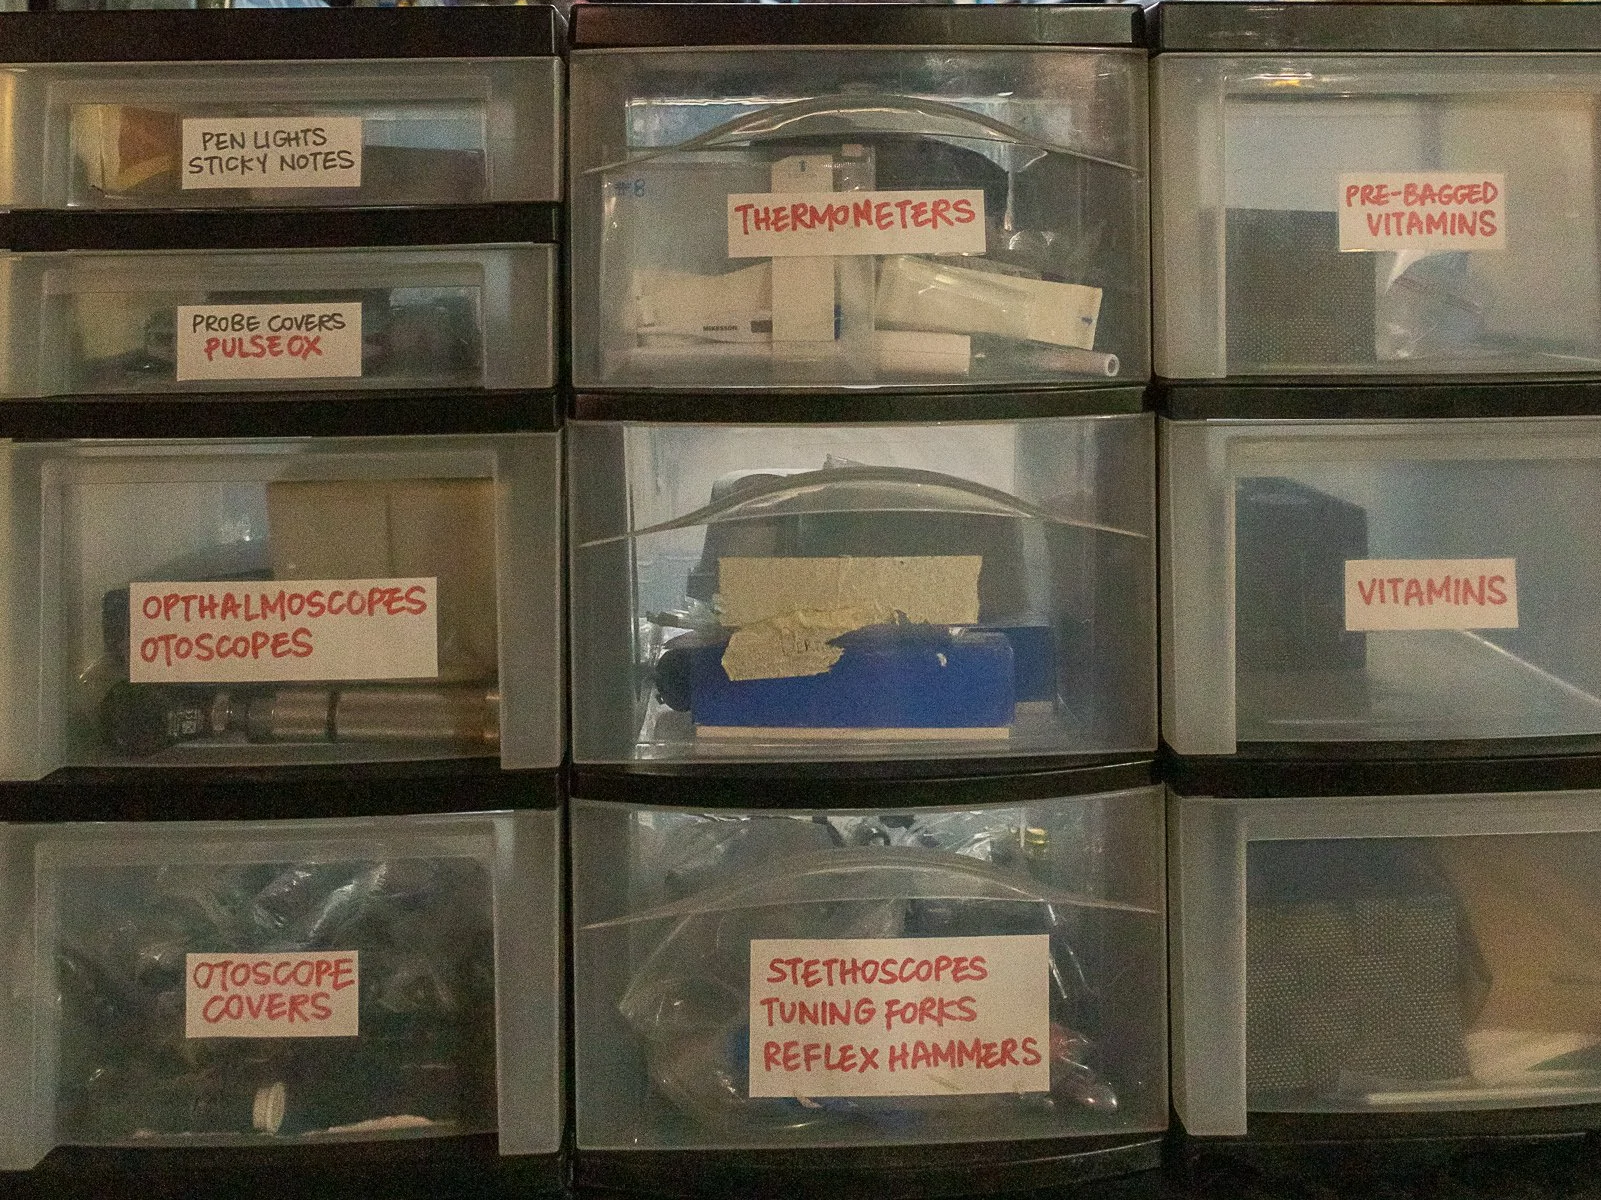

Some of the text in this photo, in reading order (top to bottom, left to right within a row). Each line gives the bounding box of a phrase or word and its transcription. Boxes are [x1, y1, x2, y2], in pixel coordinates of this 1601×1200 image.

[202, 127, 328, 151] PEN LIGHTS
[188, 150, 355, 176] STICKY NOTES
[1345, 178, 1499, 208] PRE-BAGGED
[734, 197, 976, 236] THERMOMETERS
[1366, 209, 1498, 238] VITAMINS
[192, 312, 347, 334] PROBE COVERS
[203, 334, 323, 362] PULSE OX
[142, 585, 428, 623] OPTHALMOSCOPES
[1357, 573, 1508, 606] VITAMINS
[140, 627, 314, 667] OTOSCOPES
[193, 956, 355, 990] OTOSCOPE
[766, 955, 989, 987] STETHOSCOPES
[202, 991, 333, 1023] COVERS
[761, 995, 978, 1031] TUNING FORKS
[763, 1036, 1042, 1073] REFLEX HAMMERS
